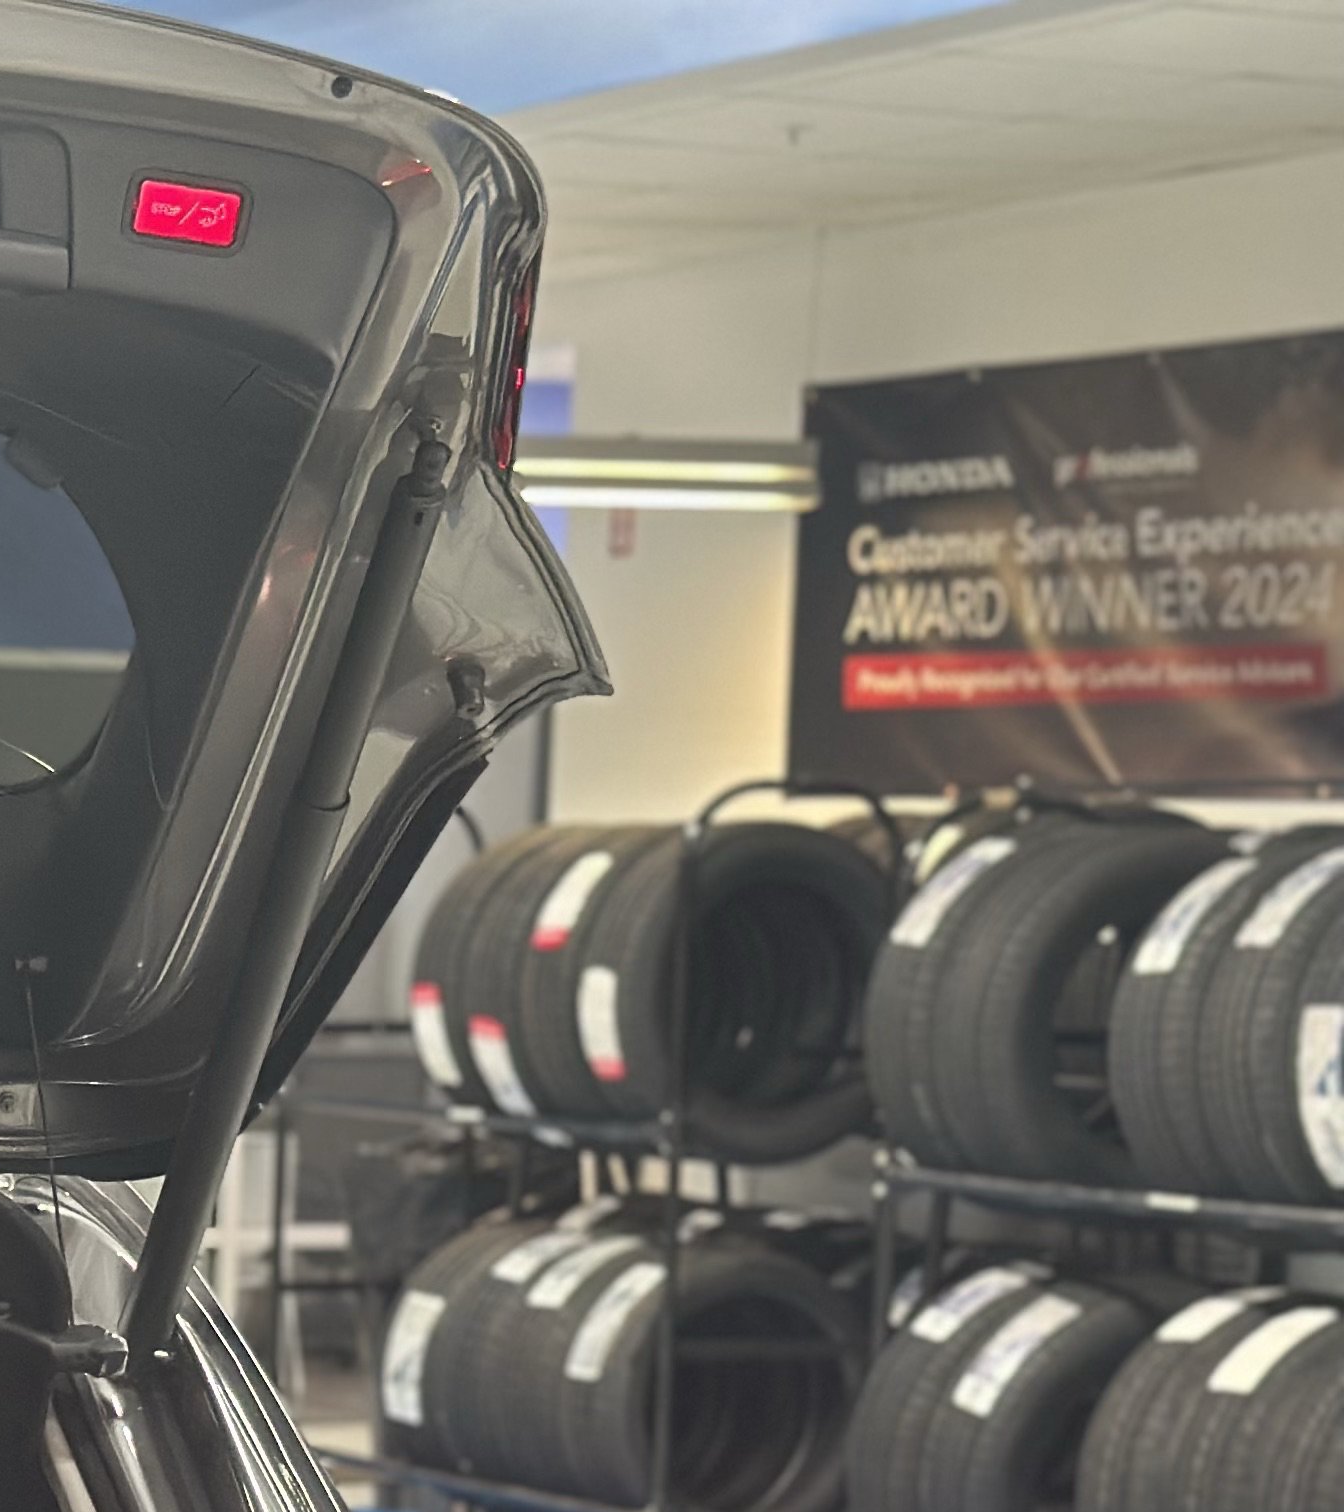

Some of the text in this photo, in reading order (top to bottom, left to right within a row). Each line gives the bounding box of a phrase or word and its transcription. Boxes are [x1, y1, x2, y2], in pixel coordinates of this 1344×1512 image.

[884, 455, 1014, 498] HONDA
[846, 525, 1006, 575] Customer
[1014, 511, 1129, 564] Service
[843, 561, 1336, 645] AWARD WINNER 2024
